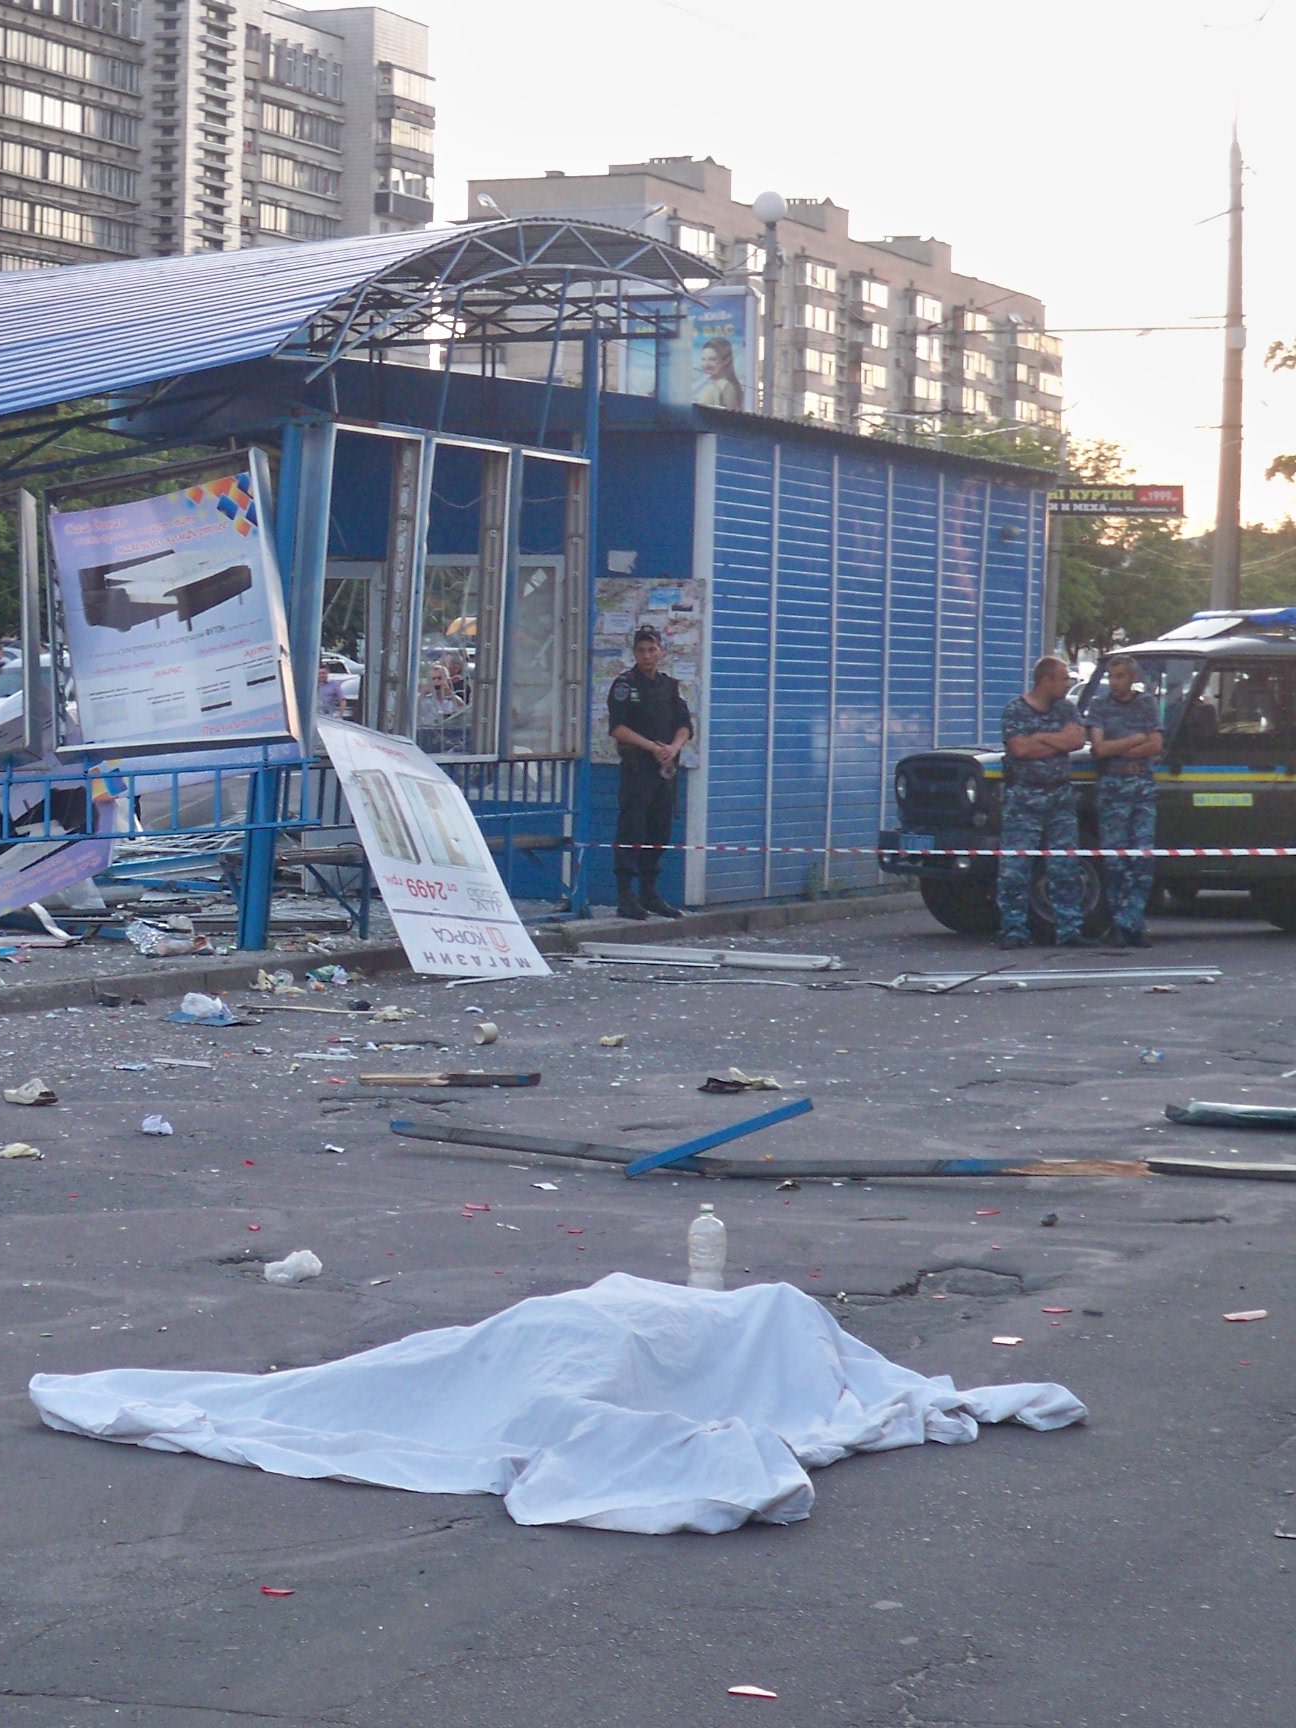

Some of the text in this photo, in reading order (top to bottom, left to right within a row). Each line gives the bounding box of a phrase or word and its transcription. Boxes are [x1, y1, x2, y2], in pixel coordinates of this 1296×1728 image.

[406, 878, 449, 900] 2499
[431, 927, 488, 946] КОРСА
[423, 951, 532, 968] МАГАЗИН
